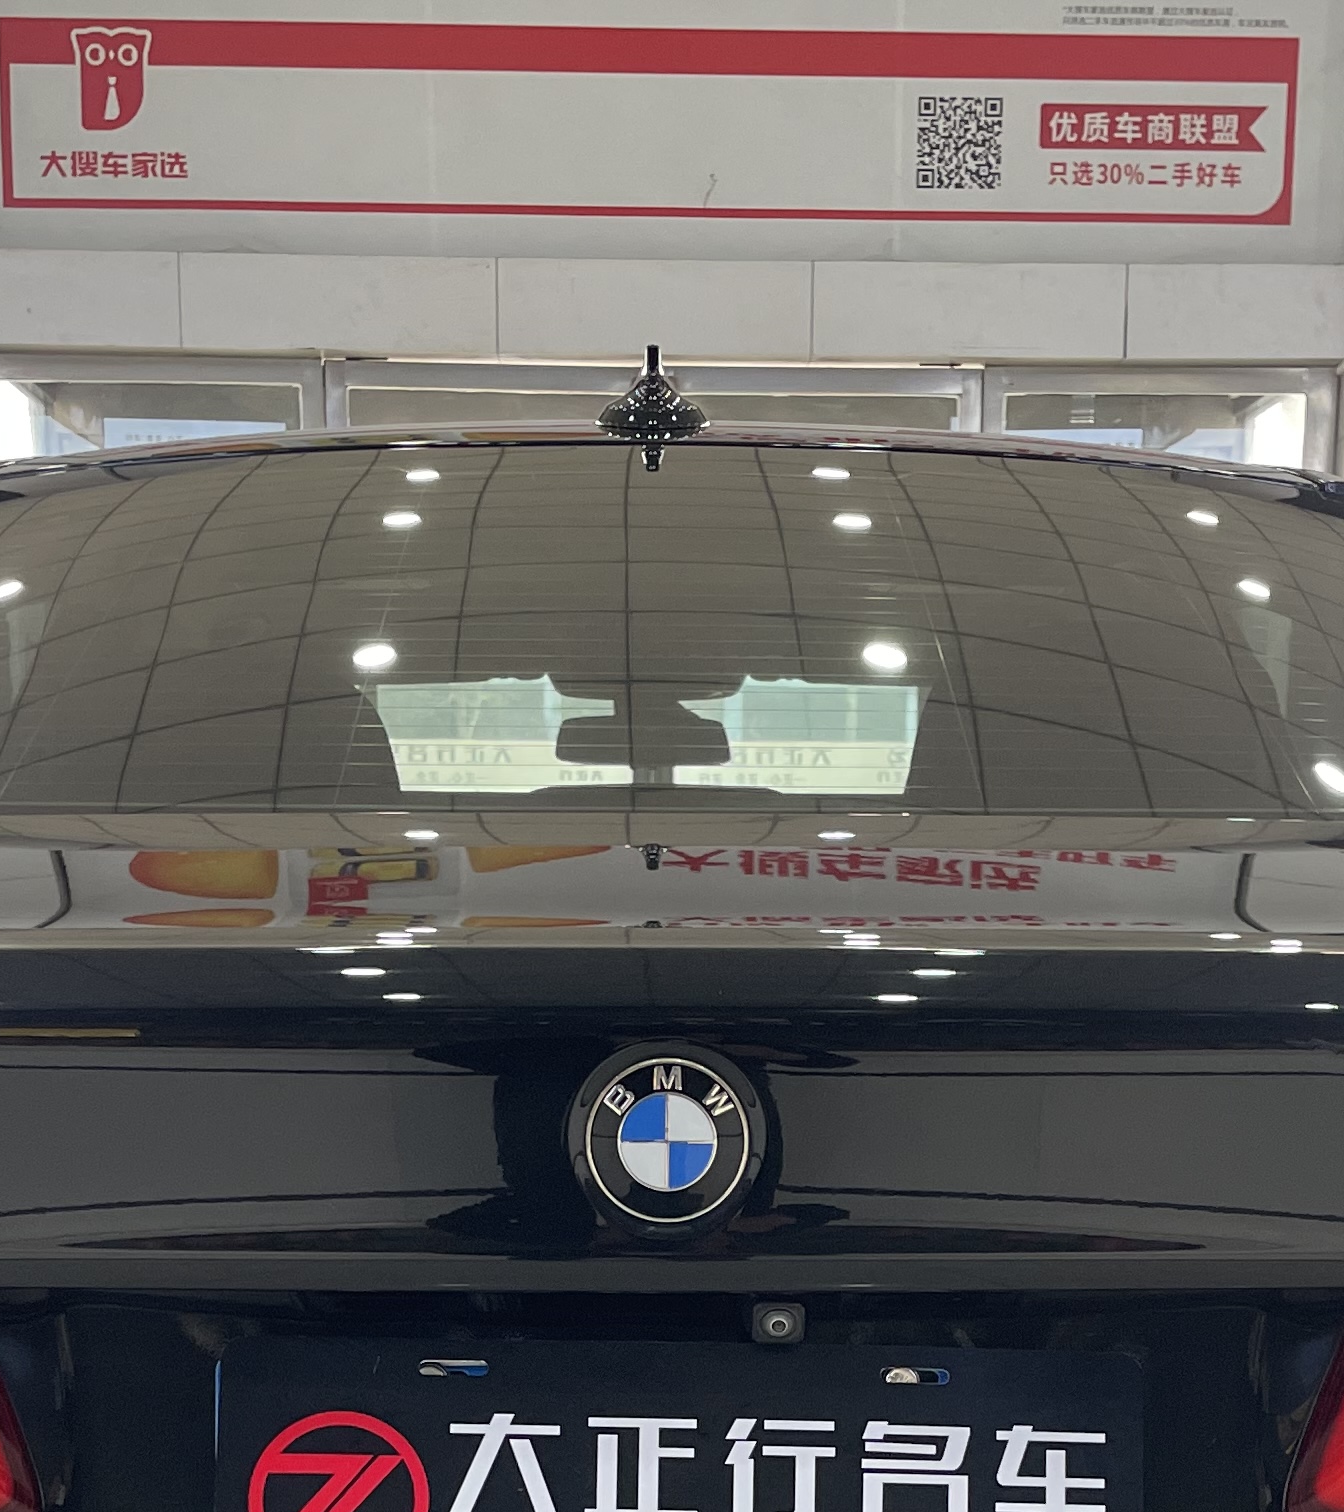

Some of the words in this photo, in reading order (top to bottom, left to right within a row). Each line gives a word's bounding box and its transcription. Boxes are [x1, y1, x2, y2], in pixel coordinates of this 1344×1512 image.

[1049, 111, 1240, 145] 优质车商联盟
[40, 150, 189, 179] 大搜车家选
[1048, 161, 1242, 188] 只选30%二手好车
[603, 1065, 735, 1117] BMW
